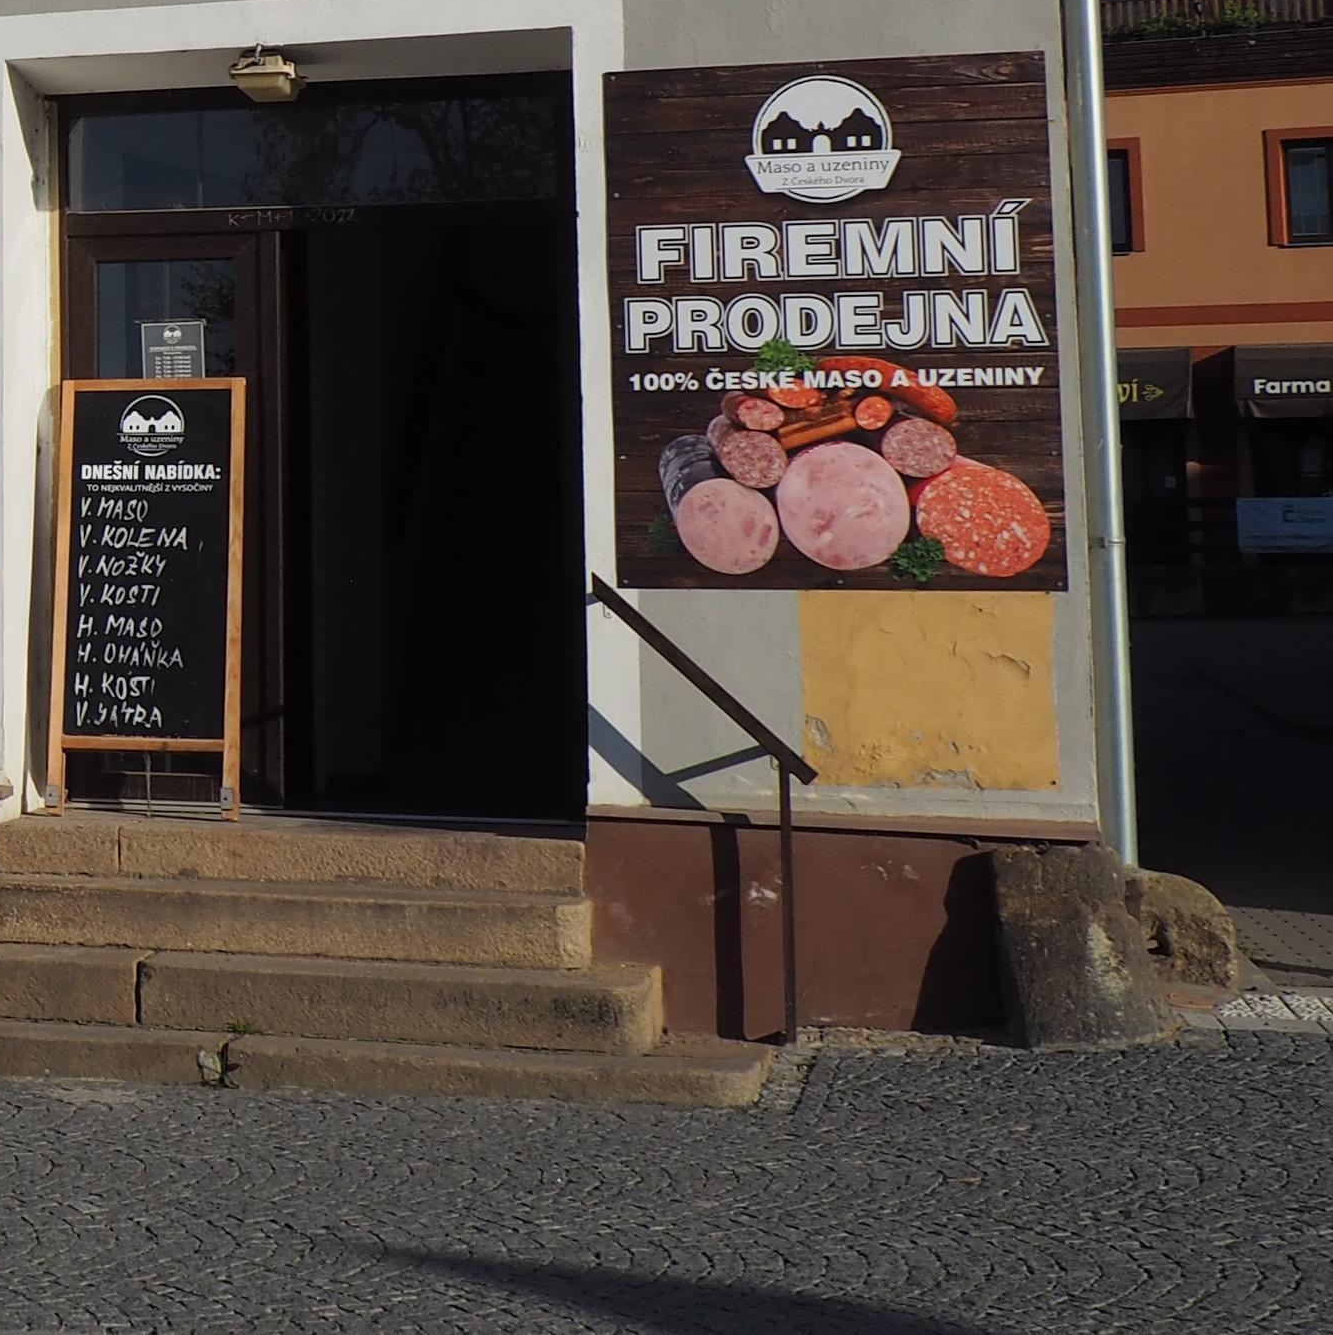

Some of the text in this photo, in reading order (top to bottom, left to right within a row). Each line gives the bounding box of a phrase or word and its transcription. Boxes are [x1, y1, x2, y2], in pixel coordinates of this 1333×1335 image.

[757, 158, 890, 174] Maso a uzeniny
[835, 176, 865, 185] Dvora
[636, 197, 1033, 284] FIREMNÍ
[624, 288, 1050, 354] PRODEJNA
[629, 367, 1045, 392] 100% ČESKÉ MASO A UZENINY
[1253, 378, 1331, 395] Farma
[120, 435, 143, 443] Maso
[151, 435, 184, 444] uzeniny
[81, 460, 221, 480] DNEŠNÍ NABÍDKA:
[86, 484, 98, 492] TO
[101, 483, 163, 493] NEJKVALITNĚJŠÍ
[172, 483, 213, 492] VYSOČINY
[97, 496, 148, 522] MASO
[101, 524, 188, 550] KOLENA
[96, 551, 166, 577] NOŽKY
[100, 583, 160, 606] KOSTI
[104, 615, 163, 638] MASO
[102, 672, 156, 700] KOSTI
